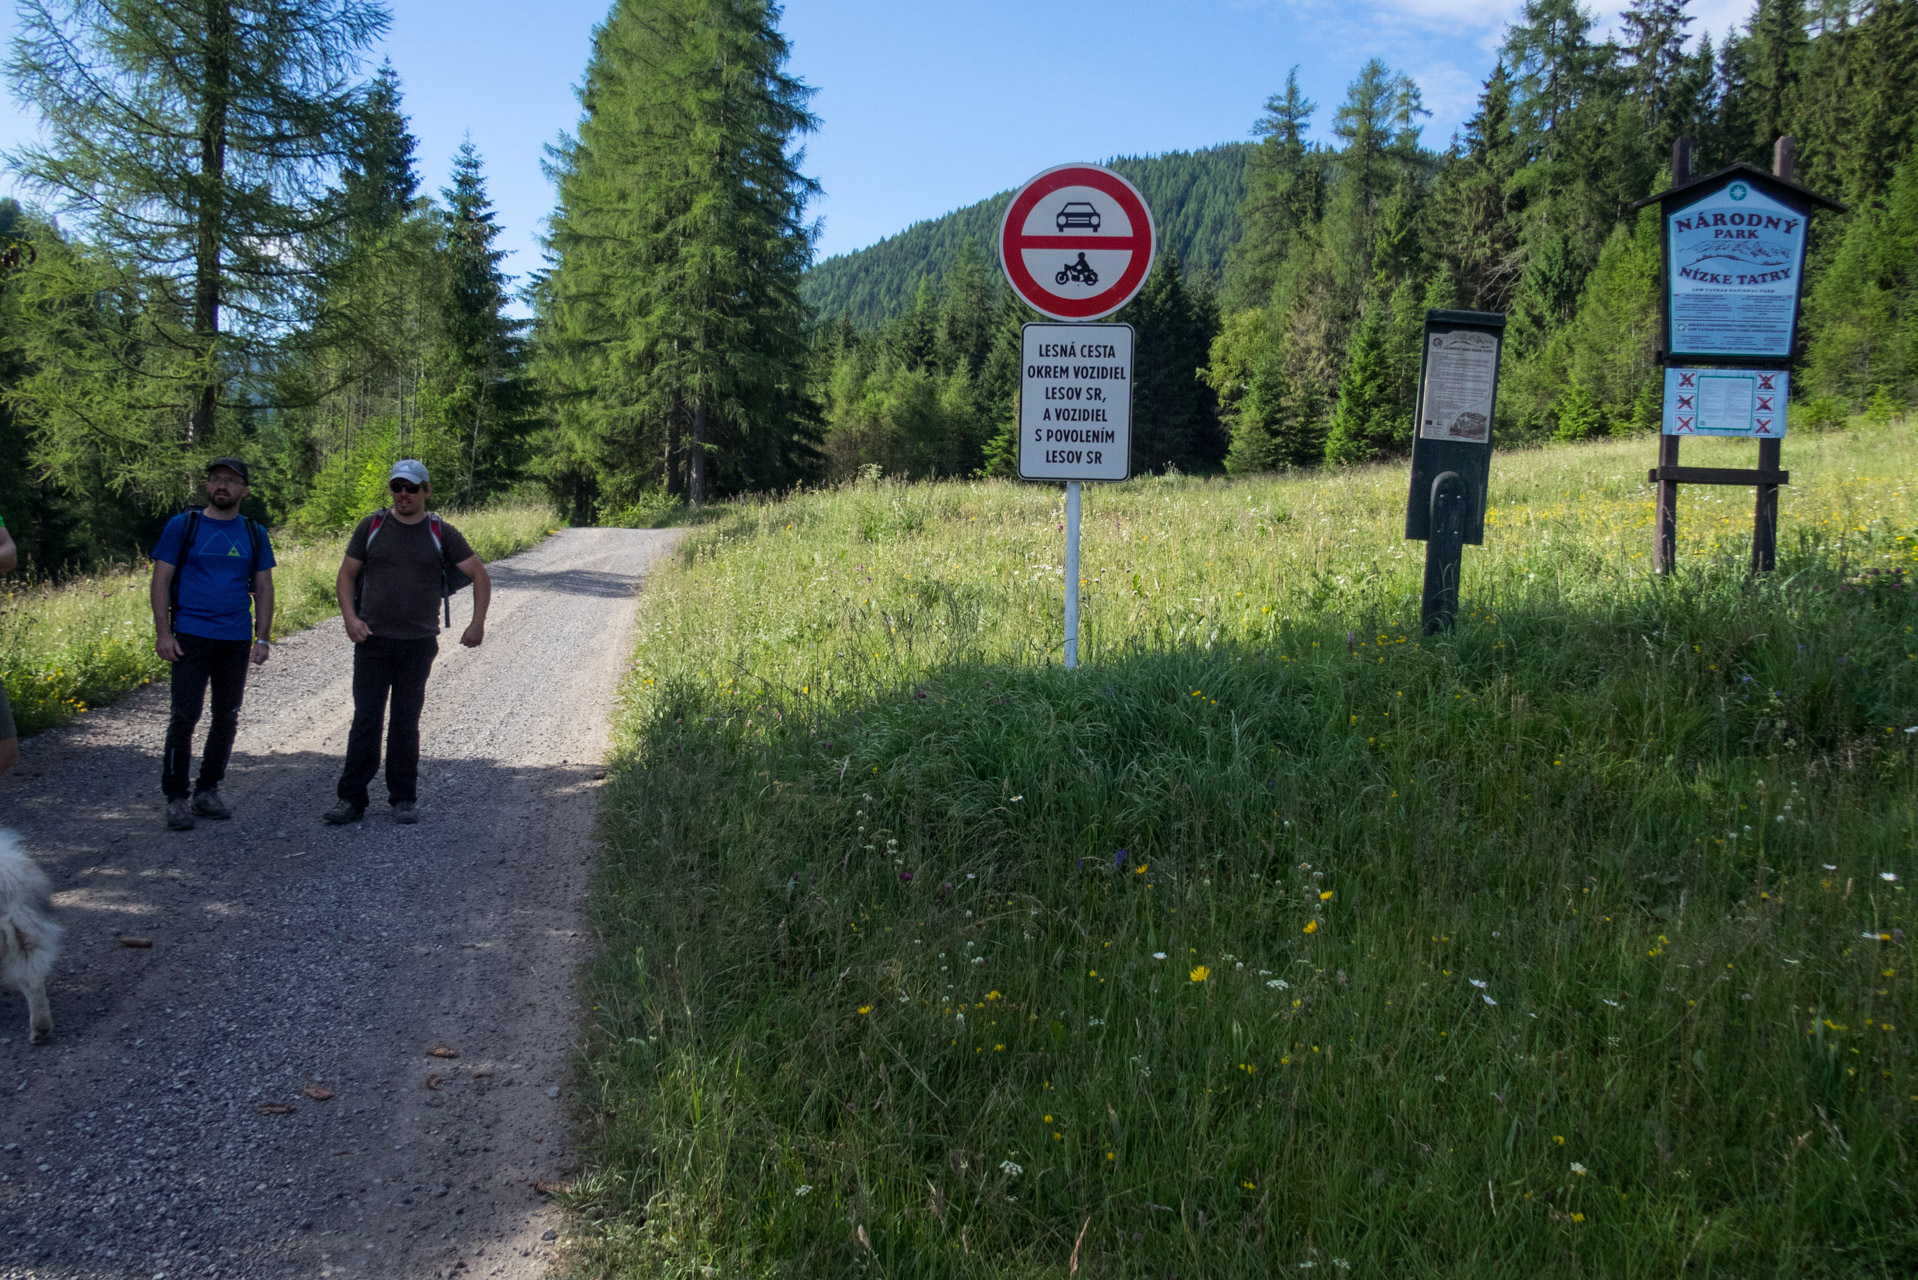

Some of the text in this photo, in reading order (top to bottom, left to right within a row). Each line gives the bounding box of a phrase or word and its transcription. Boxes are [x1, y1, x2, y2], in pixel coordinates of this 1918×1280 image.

[1675, 211, 1799, 234] NÁRODNÝ
[1714, 229, 1759, 239] PARK
[1679, 267, 1792, 285] NÍZKE TATRY
[1039, 341, 1116, 358] LESNÁ CESTA
[1027, 365, 1126, 380] OKREM VOZIDIEL
[1045, 387, 1107, 403] LESOV SR,
[1043, 408, 1108, 422] A VOZIDIEL
[1035, 427, 1115, 443] S POVOLENÍM
[1046, 450, 1102, 464] LESOV SR
